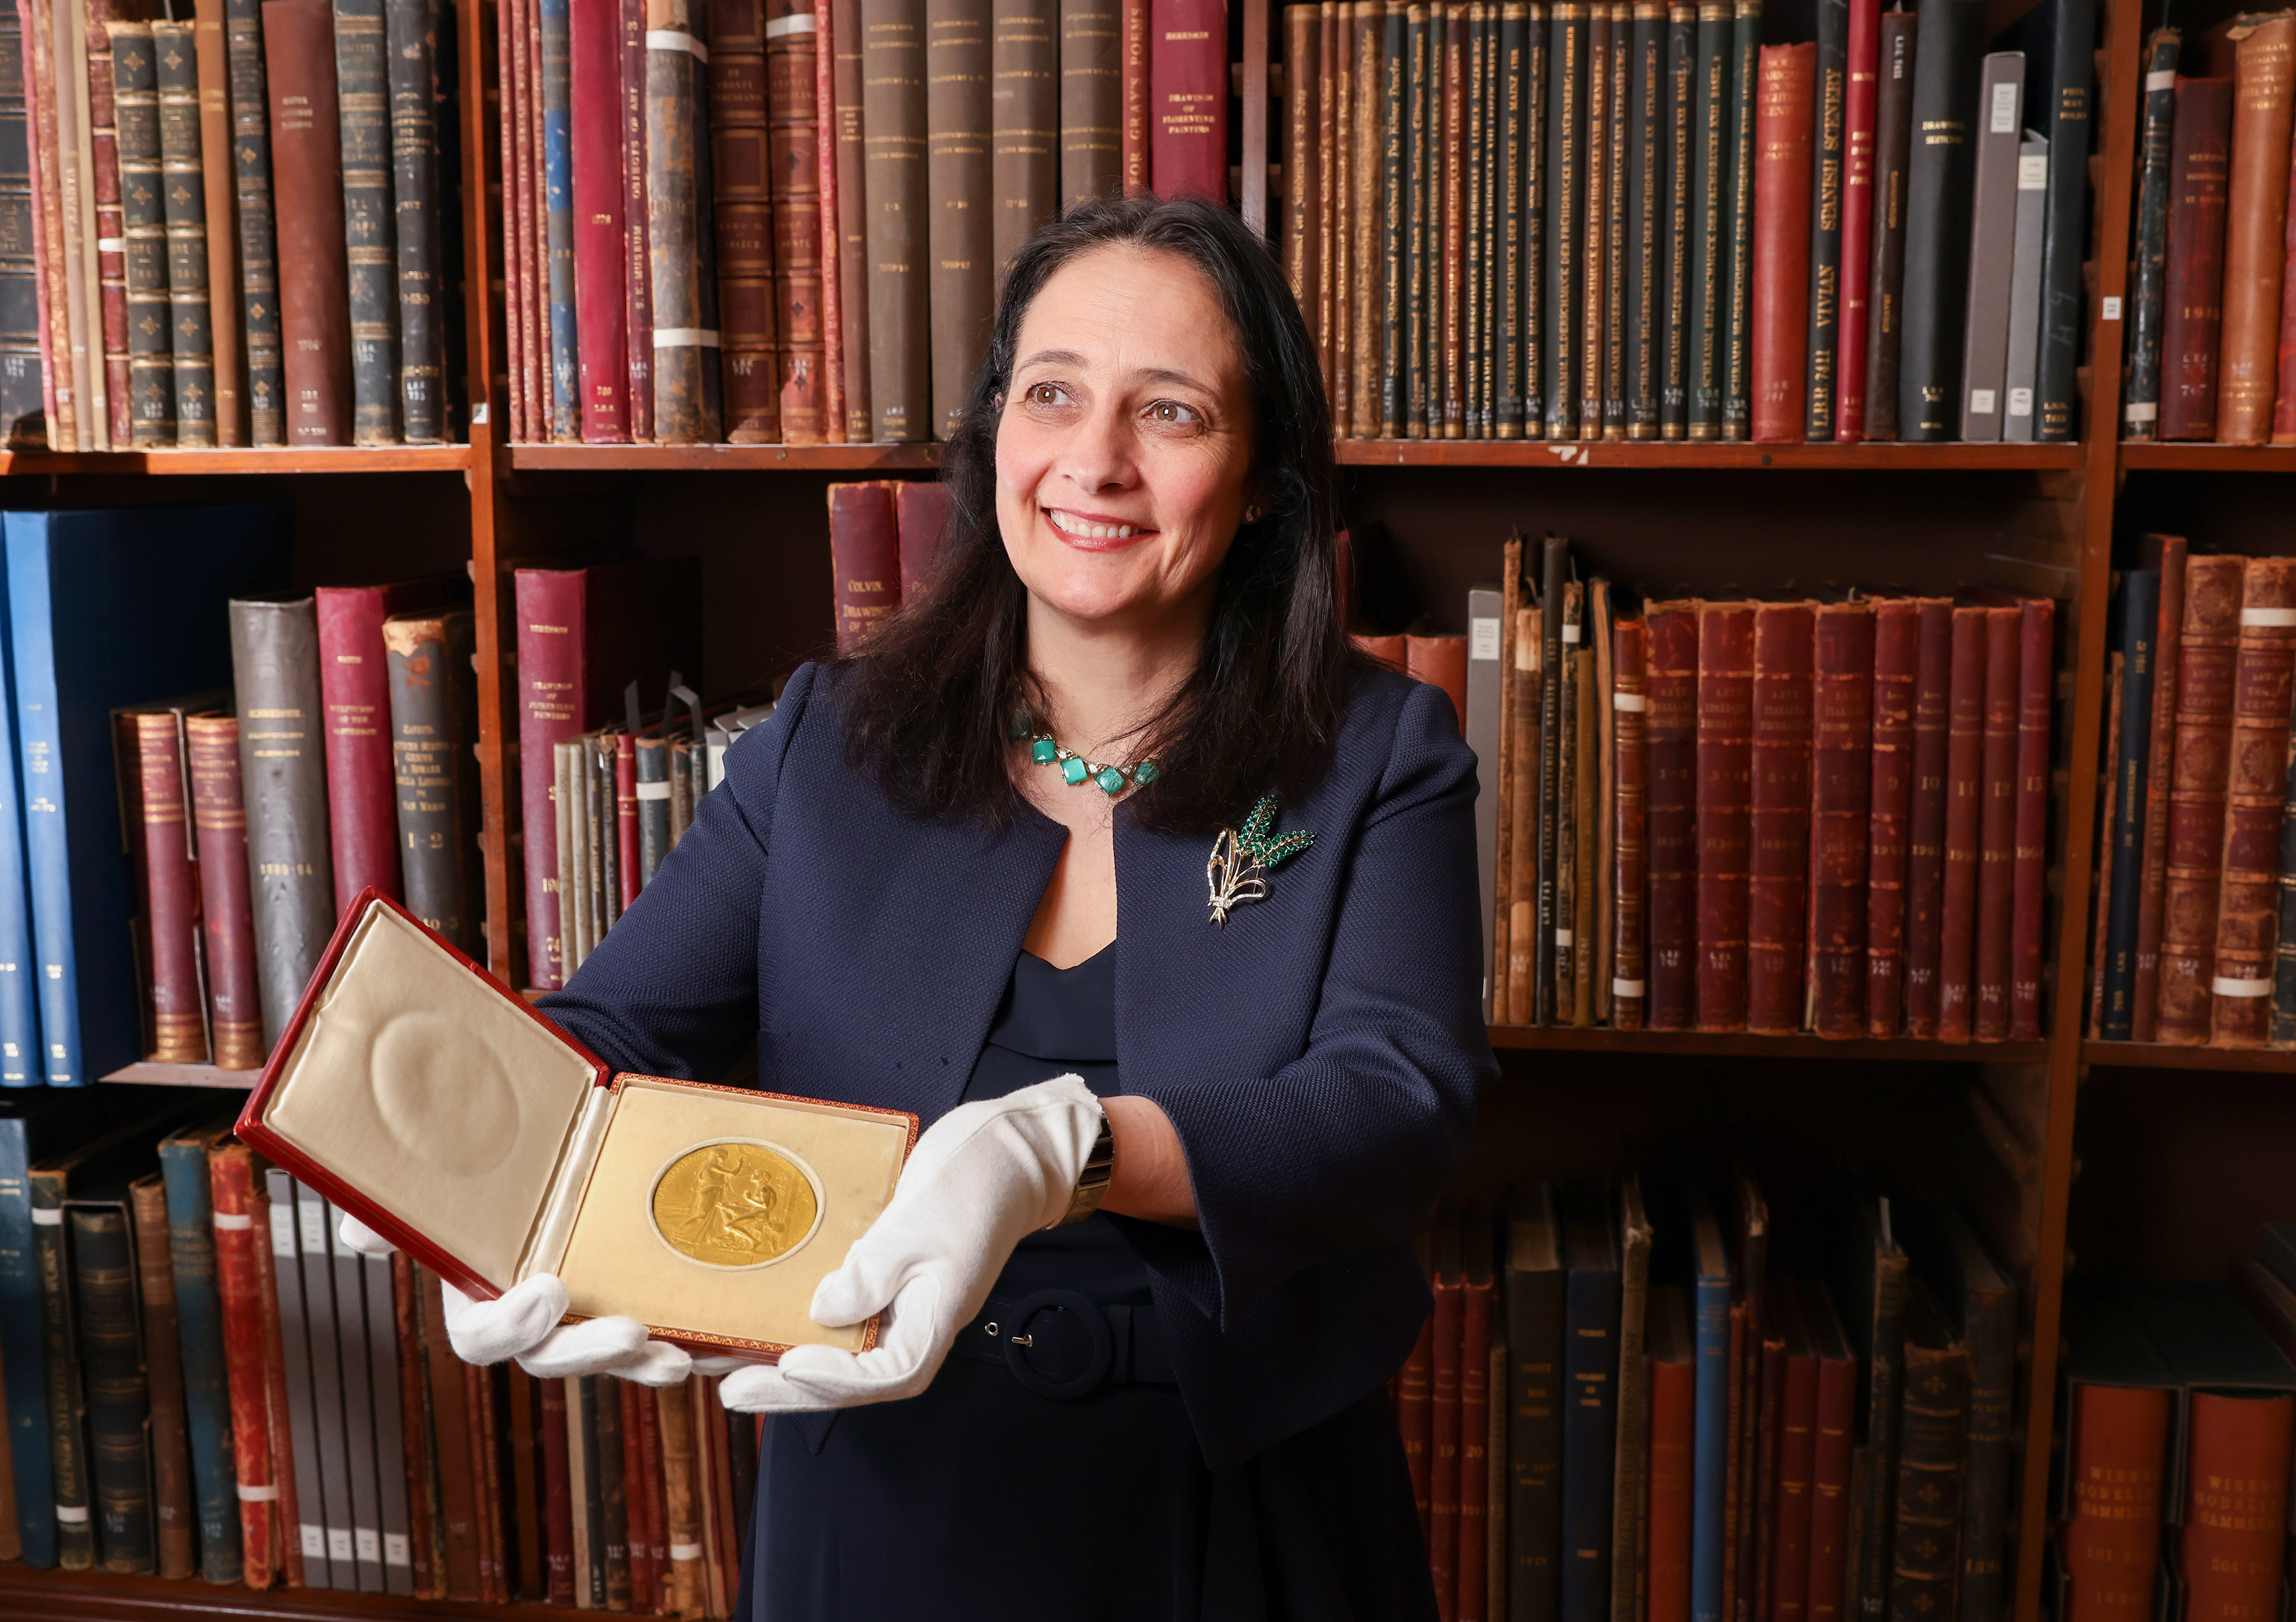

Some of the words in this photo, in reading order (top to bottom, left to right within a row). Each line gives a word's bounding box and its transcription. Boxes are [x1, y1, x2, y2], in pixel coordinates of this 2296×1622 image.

[1129, 6, 1142, 65] POEMS
[1165, 31, 1209, 41] BERENSON
[629, 87, 638, 111] ART
[1168, 94, 1214, 102] DRAWINGS
[1509, 75, 1518, 110] MAINZ
[1129, 76, 1142, 140] GRAY'S
[1162, 115, 1216, 124] FLORENTINE
[1182, 104, 1195, 113] OF
[1823, 66, 1842, 151] SCENERY
[1168, 126, 1211, 134] PAINTERS
[630, 140, 640, 199] OBJECTS
[1820, 158, 1839, 230] SPANISH
[1508, 219, 1517, 241] DER
[1589, 226, 1599, 247] DER
[1612, 224, 1623, 246] DER
[1642, 221, 1653, 244] DER
[633, 226, 644, 280] MUSEUM
[1560, 242, 1571, 265] DER
[1816, 263, 1835, 328] VIVIAN
[1546, 678, 1556, 726] STUDIES
[1544, 735, 1554, 800] ANATOMICAL
[1922, 776, 1939, 790] 10
[2152, 742, 2170, 846] SHERBORNE
[1543, 814, 1552, 860] FLAXMAN
[1439, 1444, 1455, 1458] 19
[1466, 1445, 1483, 1458] 20
